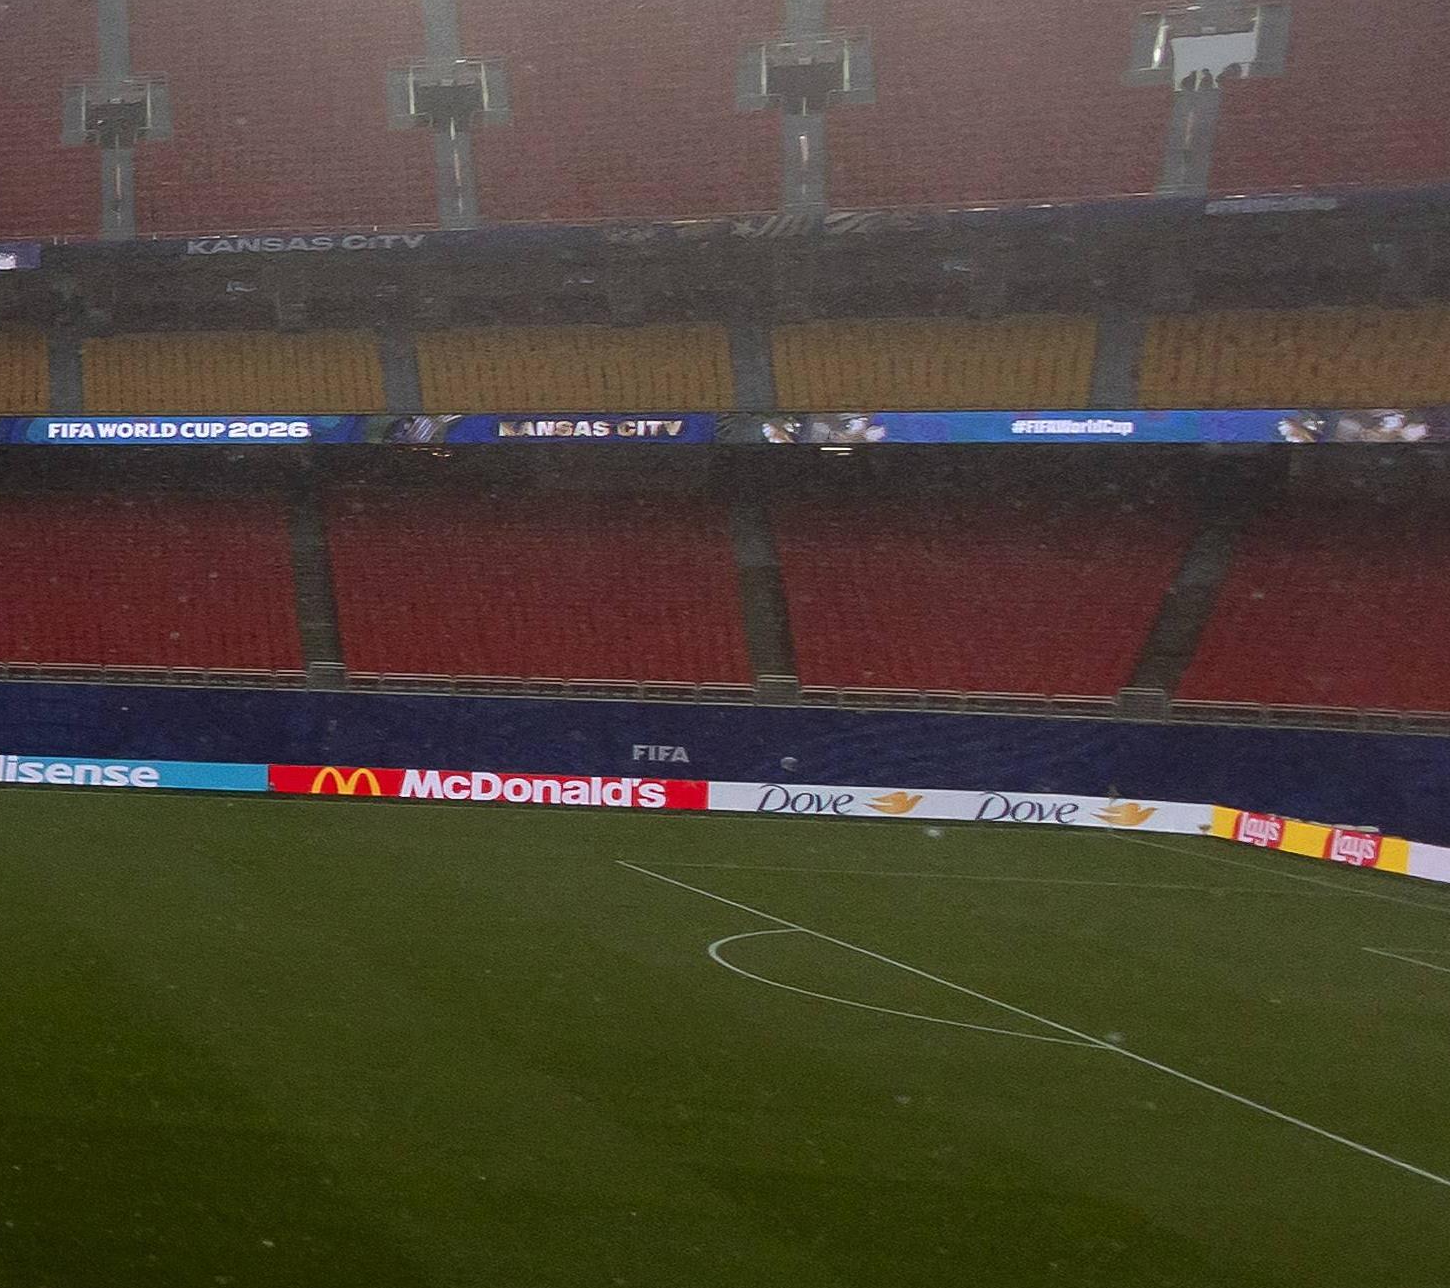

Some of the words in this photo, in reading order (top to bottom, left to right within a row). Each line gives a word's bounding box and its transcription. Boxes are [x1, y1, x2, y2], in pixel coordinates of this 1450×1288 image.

[186, 235, 335, 255] KANSAS
[341, 234, 427, 251] CITY
[48, 423, 95, 439] FIFA
[97, 423, 176, 438] WORLD
[179, 423, 226, 438] CUP
[228, 422, 310, 438] 2026
[498, 421, 612, 437] KANSAS
[616, 421, 683, 437] CITY
[633, 744, 690, 763] FIFA
[400, 769, 666, 808] McDonald's
[757, 783, 855, 815] Dove
[975, 791, 1079, 824] Dove
